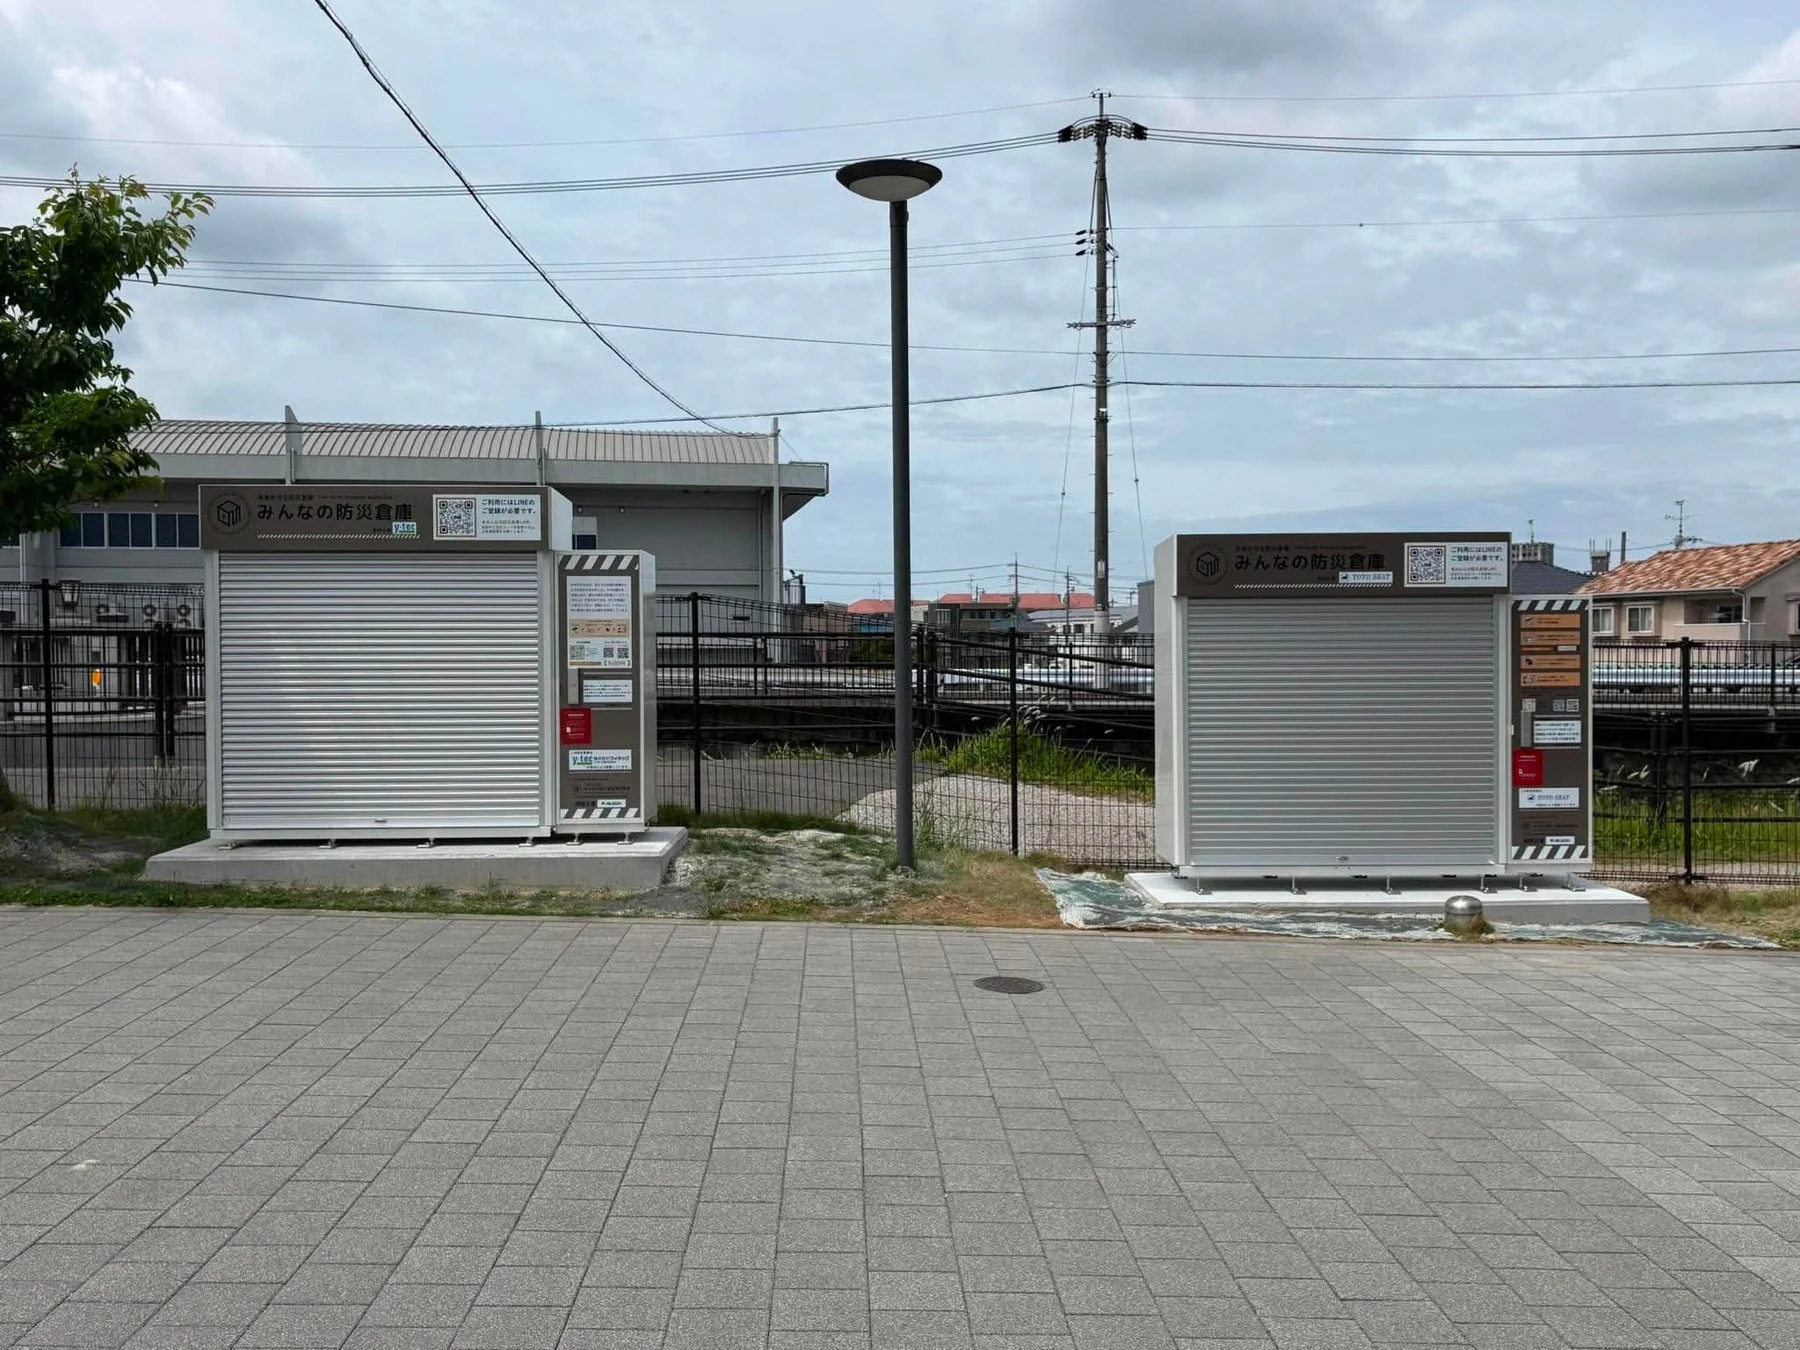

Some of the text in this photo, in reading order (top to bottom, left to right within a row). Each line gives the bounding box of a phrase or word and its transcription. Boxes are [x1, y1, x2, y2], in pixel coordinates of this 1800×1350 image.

[257, 503, 413, 521] みんなの防災倉庫
[1234, 553, 1386, 570] みんなの防災倉庫
